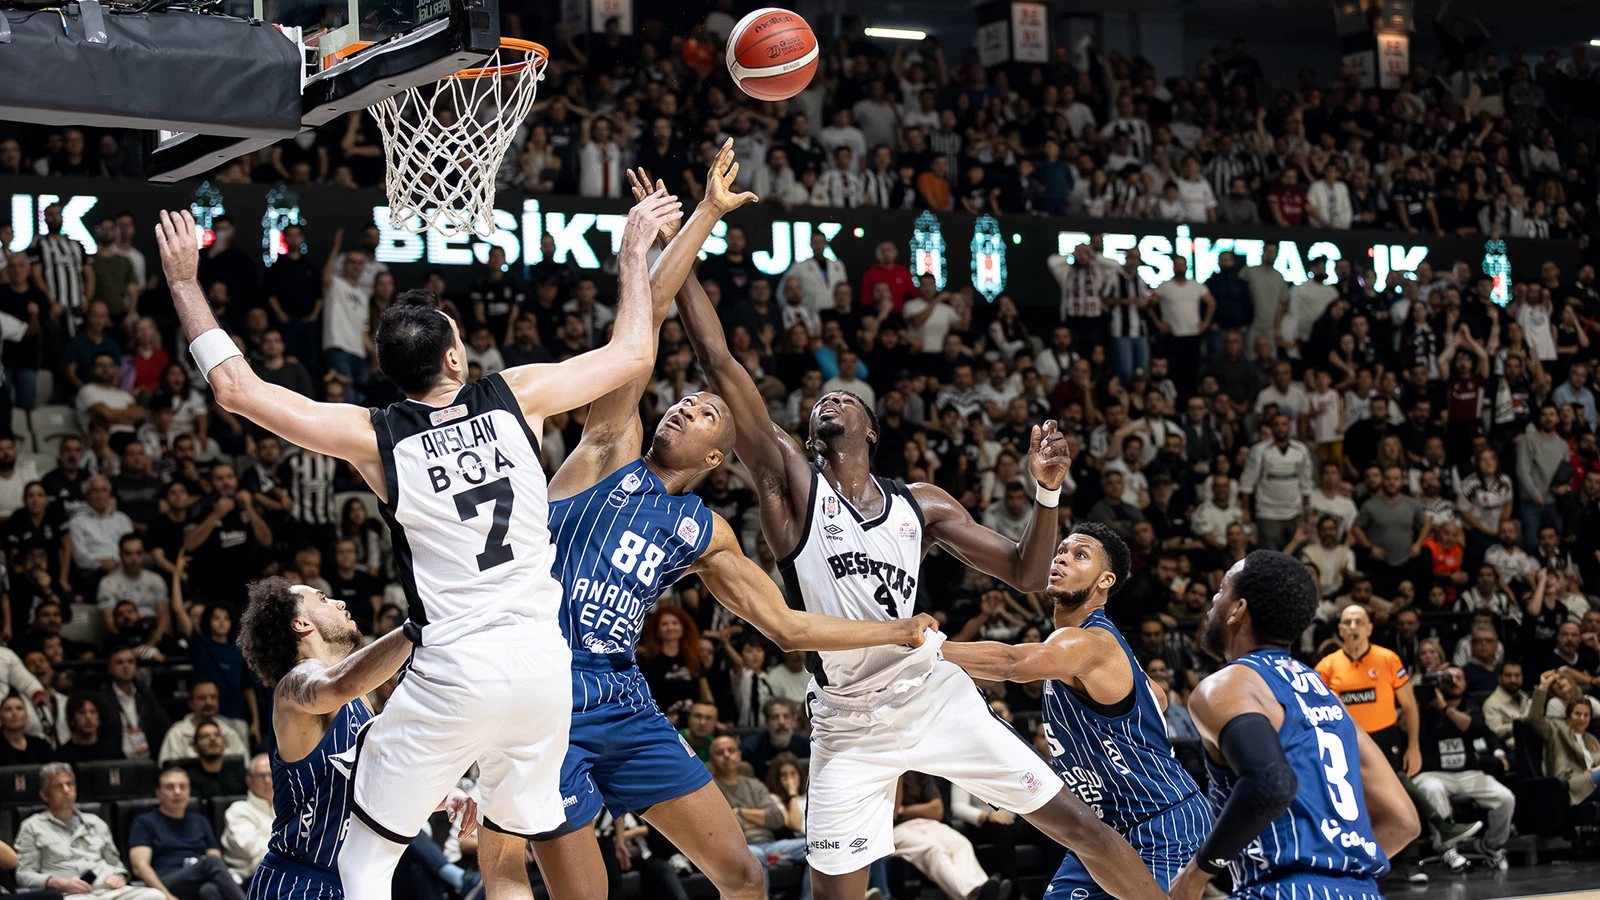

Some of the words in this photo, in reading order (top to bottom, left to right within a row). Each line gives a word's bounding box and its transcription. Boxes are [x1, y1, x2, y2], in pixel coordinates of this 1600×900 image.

[754, 16, 793, 33] molten
[421, 415, 498, 460] ARSLAN
[427, 447, 515, 494] BOA
[453, 477, 515, 571] 7
[611, 530, 666, 587] 88
[1315, 726, 1359, 821] 3
